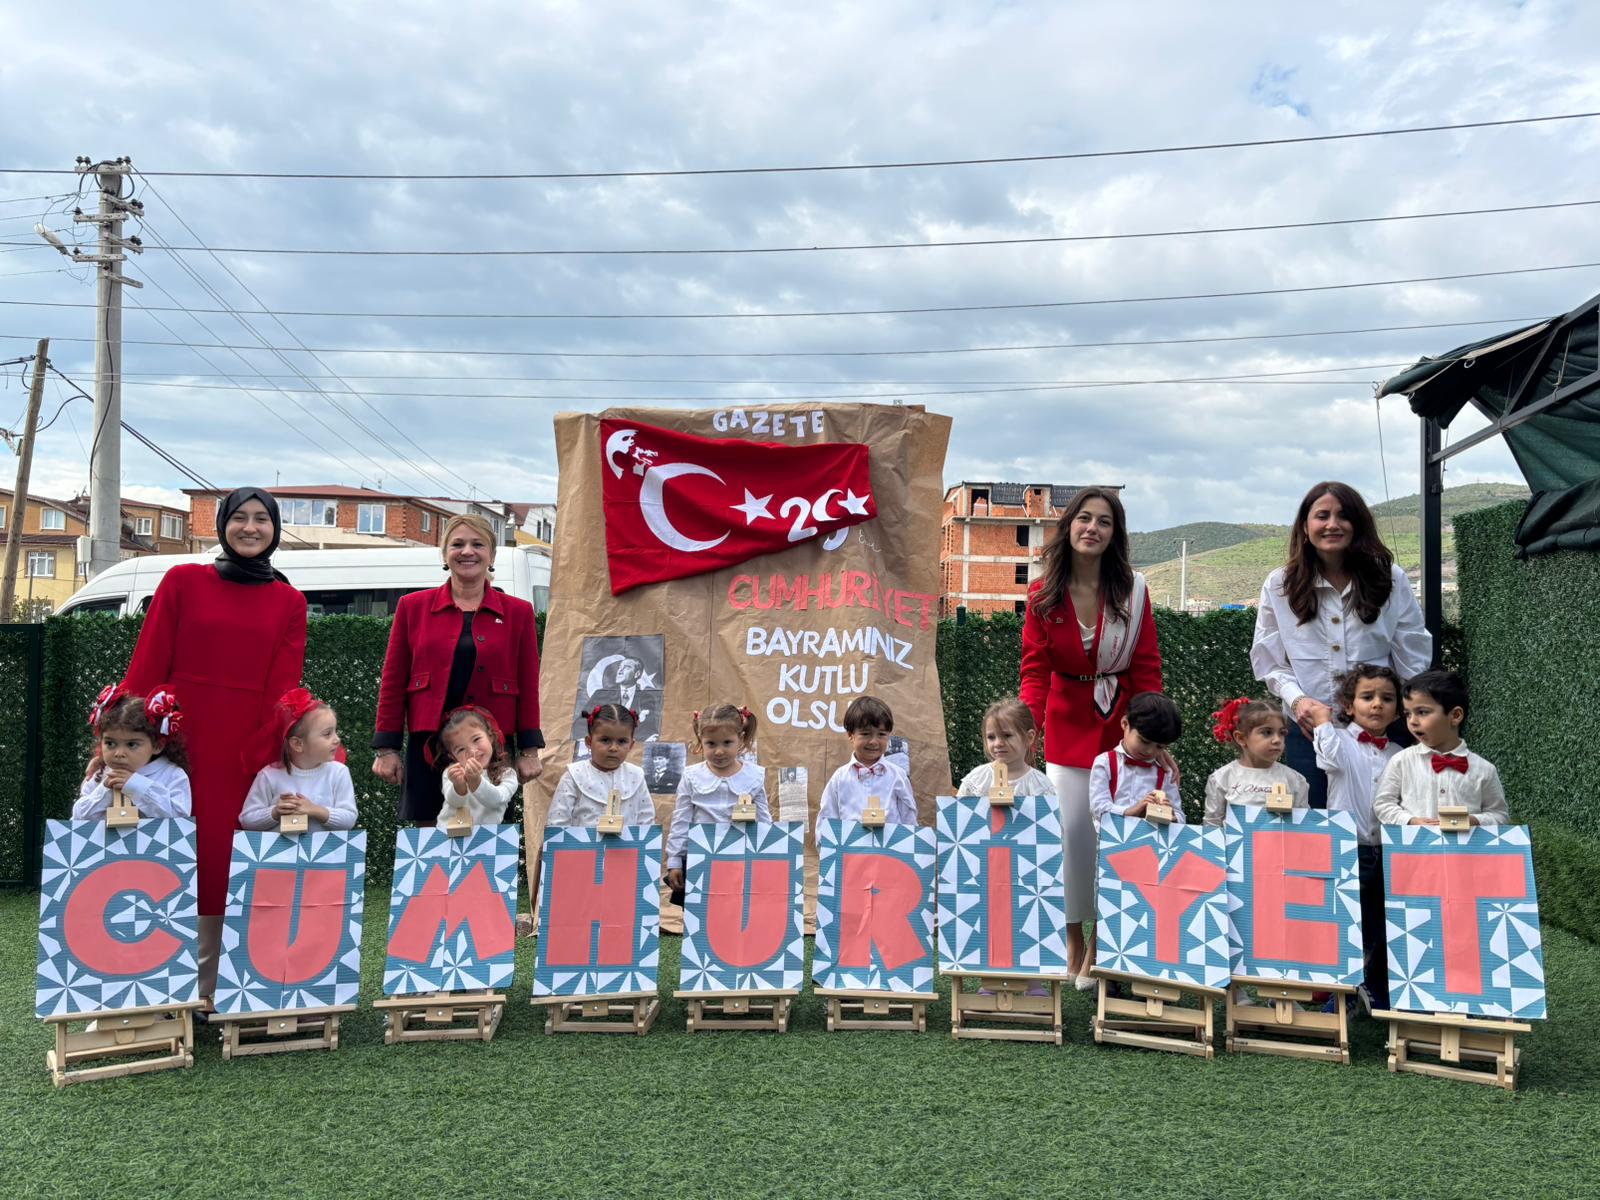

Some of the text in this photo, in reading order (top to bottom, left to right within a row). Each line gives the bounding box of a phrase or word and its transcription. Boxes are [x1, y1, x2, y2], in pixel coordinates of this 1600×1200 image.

[712, 408, 824, 438] GAZETE
[727, 569, 940, 632] CUMHURİYET
[746, 626, 914, 670] BAYRAMINIZ
[778, 662, 869, 695] KUTLU
[766, 696, 848, 733] OLSU
